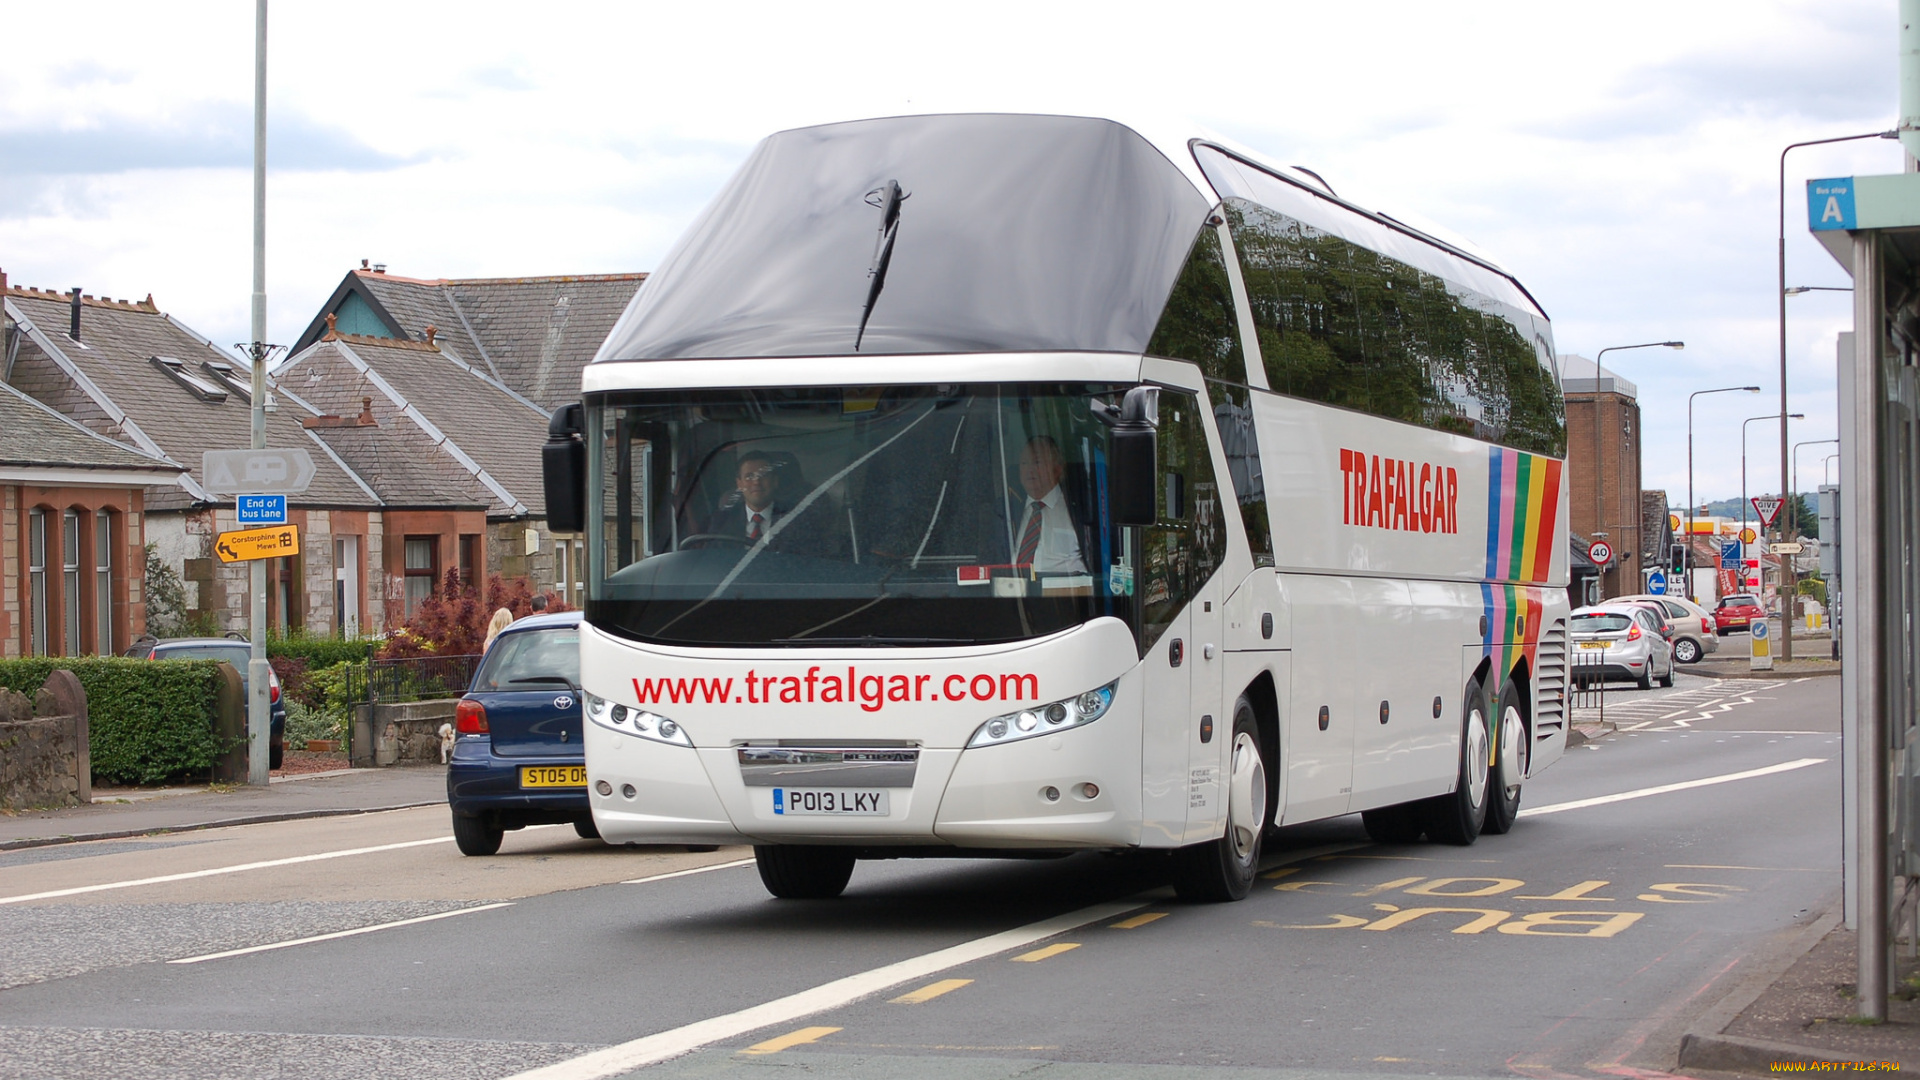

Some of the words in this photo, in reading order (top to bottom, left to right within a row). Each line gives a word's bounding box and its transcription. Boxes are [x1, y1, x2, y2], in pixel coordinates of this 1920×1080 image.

[1816, 187, 1829, 195] Bus
[1831, 187, 1847, 195] stop
[1821, 196, 1844, 222] A
[1340, 448, 1458, 534] TRAFALGAR
[246, 499, 264, 508] End
[267, 499, 277, 508] of
[242, 509, 259, 518] bus
[261, 509, 282, 518] lane
[231, 534, 276, 544] Corstorphine
[1593, 548, 1608, 557] 40
[632, 666, 1039, 712] www.trafalgar.com
[529, 769, 567, 783] ST05
[790, 792, 835, 811] PO13
[841, 792, 880, 812] LKY
